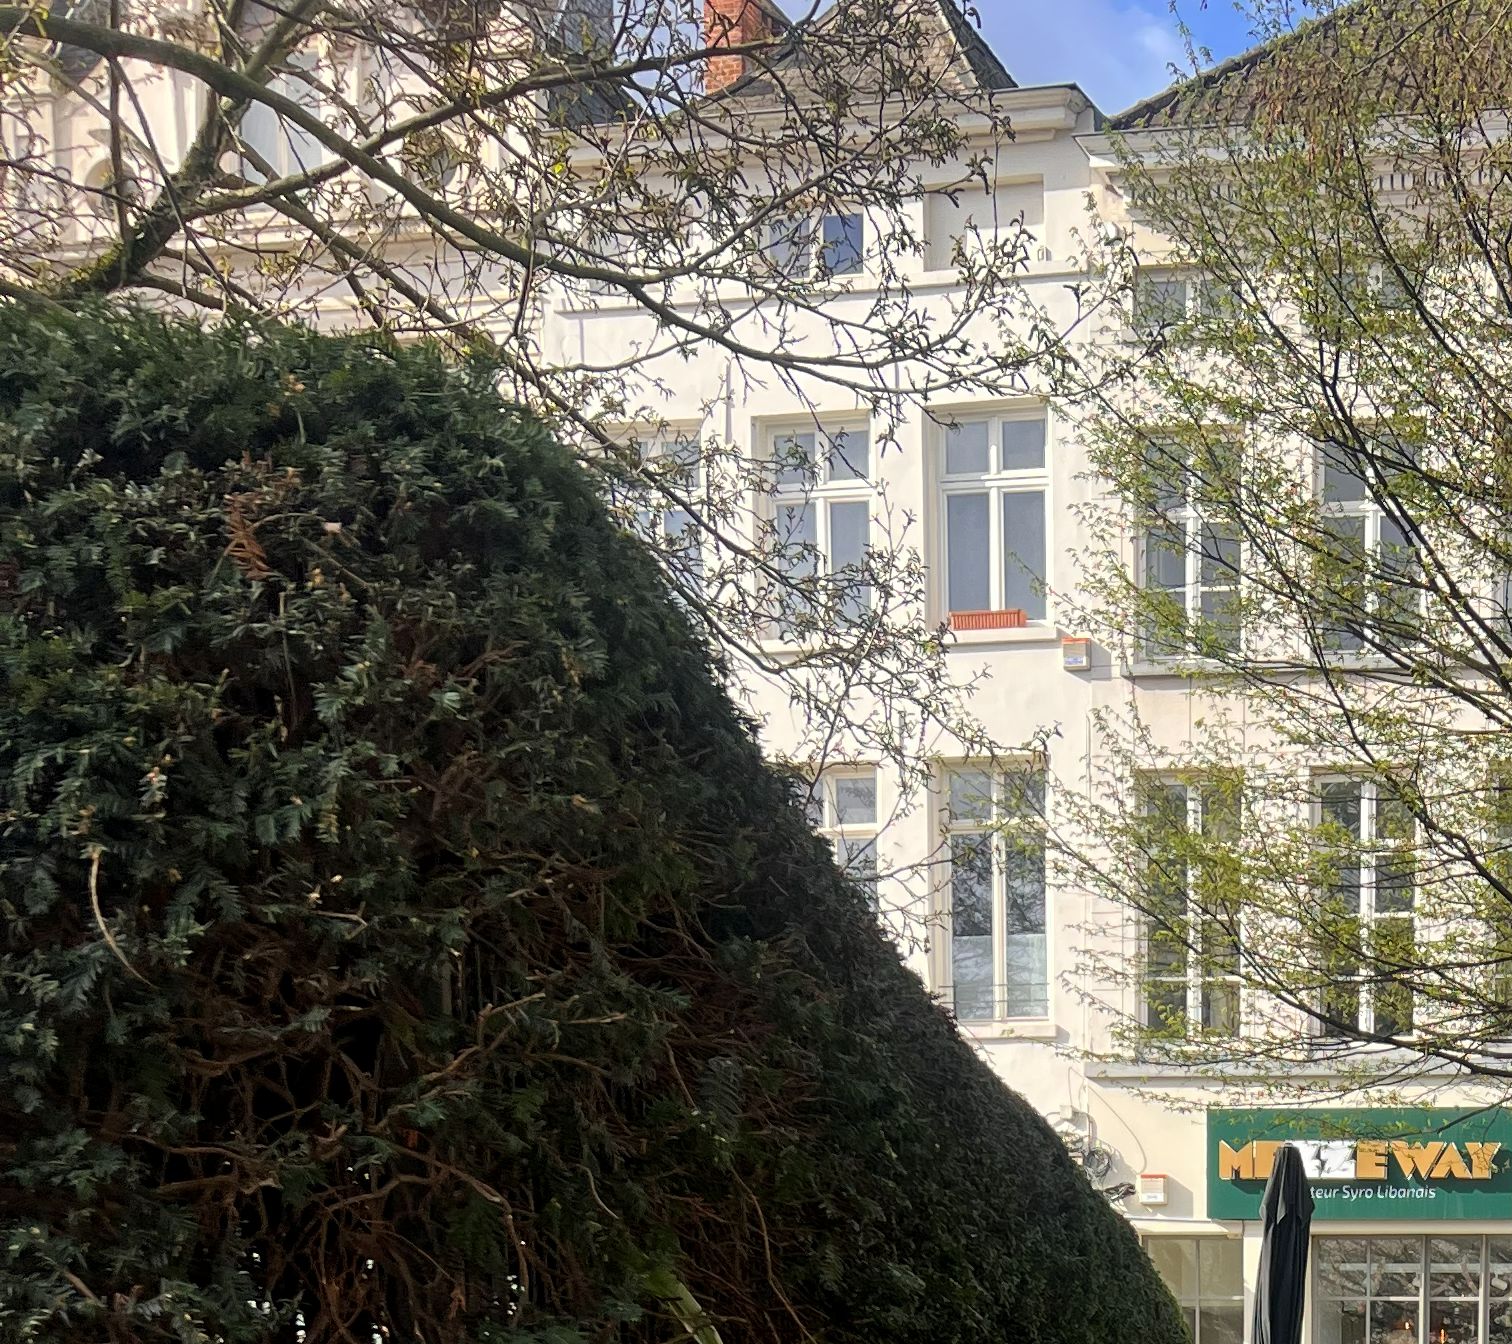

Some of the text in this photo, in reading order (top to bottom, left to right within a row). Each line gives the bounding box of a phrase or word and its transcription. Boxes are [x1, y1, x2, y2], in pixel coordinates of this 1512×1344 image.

[1309, 1184, 1436, 1202] teur Syro Libanais
